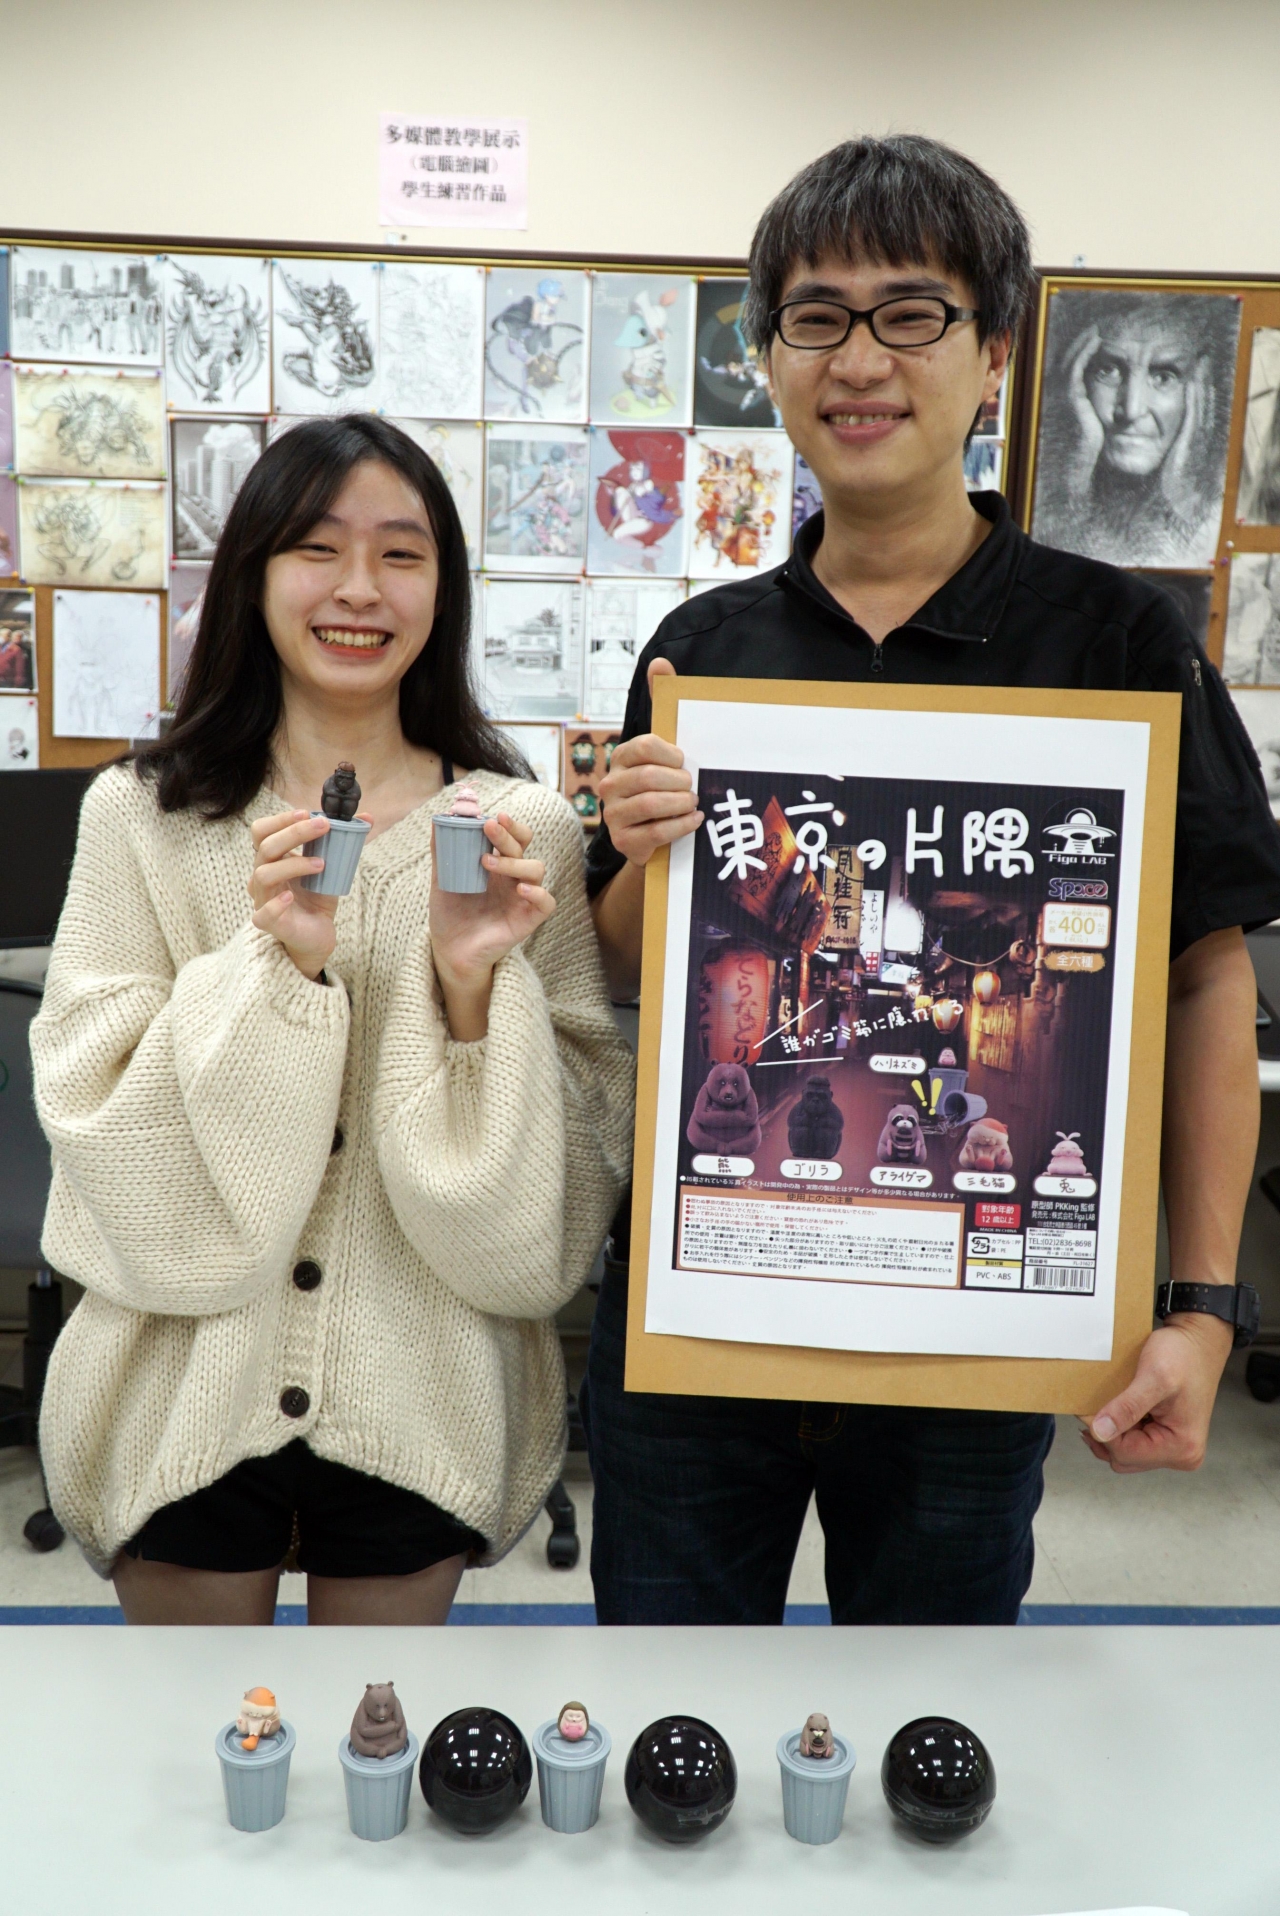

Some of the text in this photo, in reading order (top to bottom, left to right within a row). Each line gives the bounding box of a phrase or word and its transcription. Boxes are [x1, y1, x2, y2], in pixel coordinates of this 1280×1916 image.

[385, 124, 521, 149] 多媒體教學展示
[401, 180, 507, 202] 學生練習作品
[706, 788, 1034, 879] 東京の片隅
[1049, 854, 1107, 865] Figa LAB
[1049, 878, 1108, 900] Space
[1058, 916, 1096, 935] 400
[1056, 954, 1094, 968] 全六種
[874, 1058, 917, 1070] ハリネズミ
[793, 1162, 829, 1178] ゴリラ
[879, 1170, 927, 1183] アライグマ
[967, 1176, 1006, 1189] 三毛猫
[786, 1192, 854, 1205] 使用上のご注意
[1055, 1202, 1079, 1212] PKKing
[981, 1215, 991, 1224] 12
